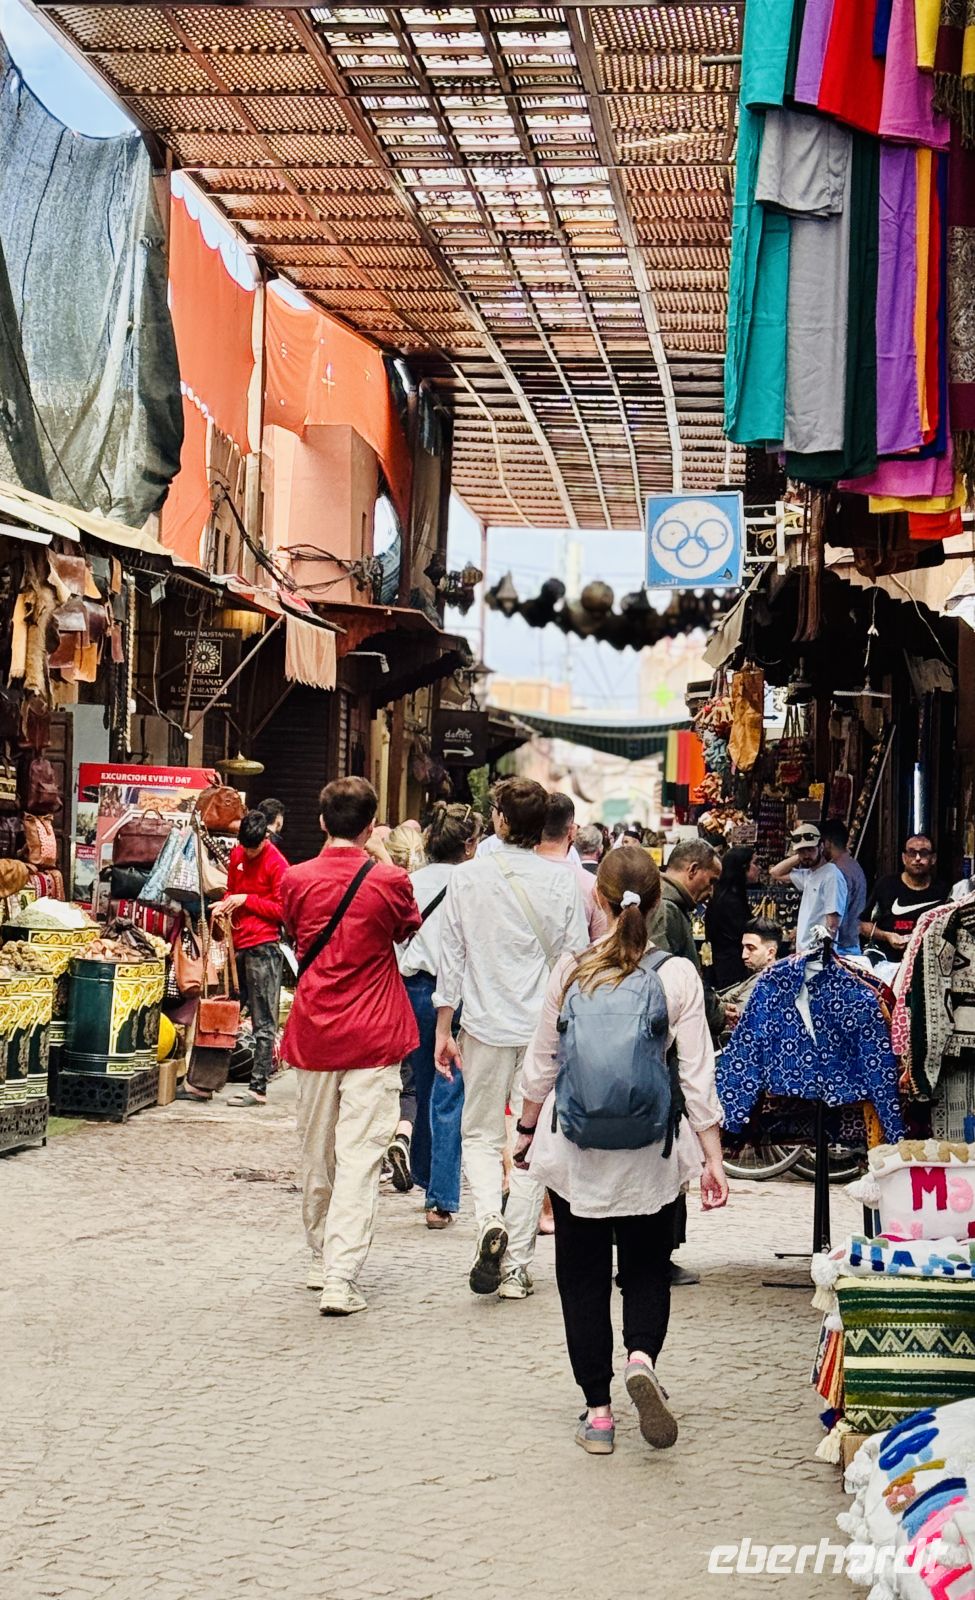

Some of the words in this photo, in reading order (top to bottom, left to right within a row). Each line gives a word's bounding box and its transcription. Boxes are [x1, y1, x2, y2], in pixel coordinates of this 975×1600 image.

[182, 678, 224, 686] ATISANAT
[147, 774, 174, 783] EVERY
[174, 776, 192, 784] DAY
